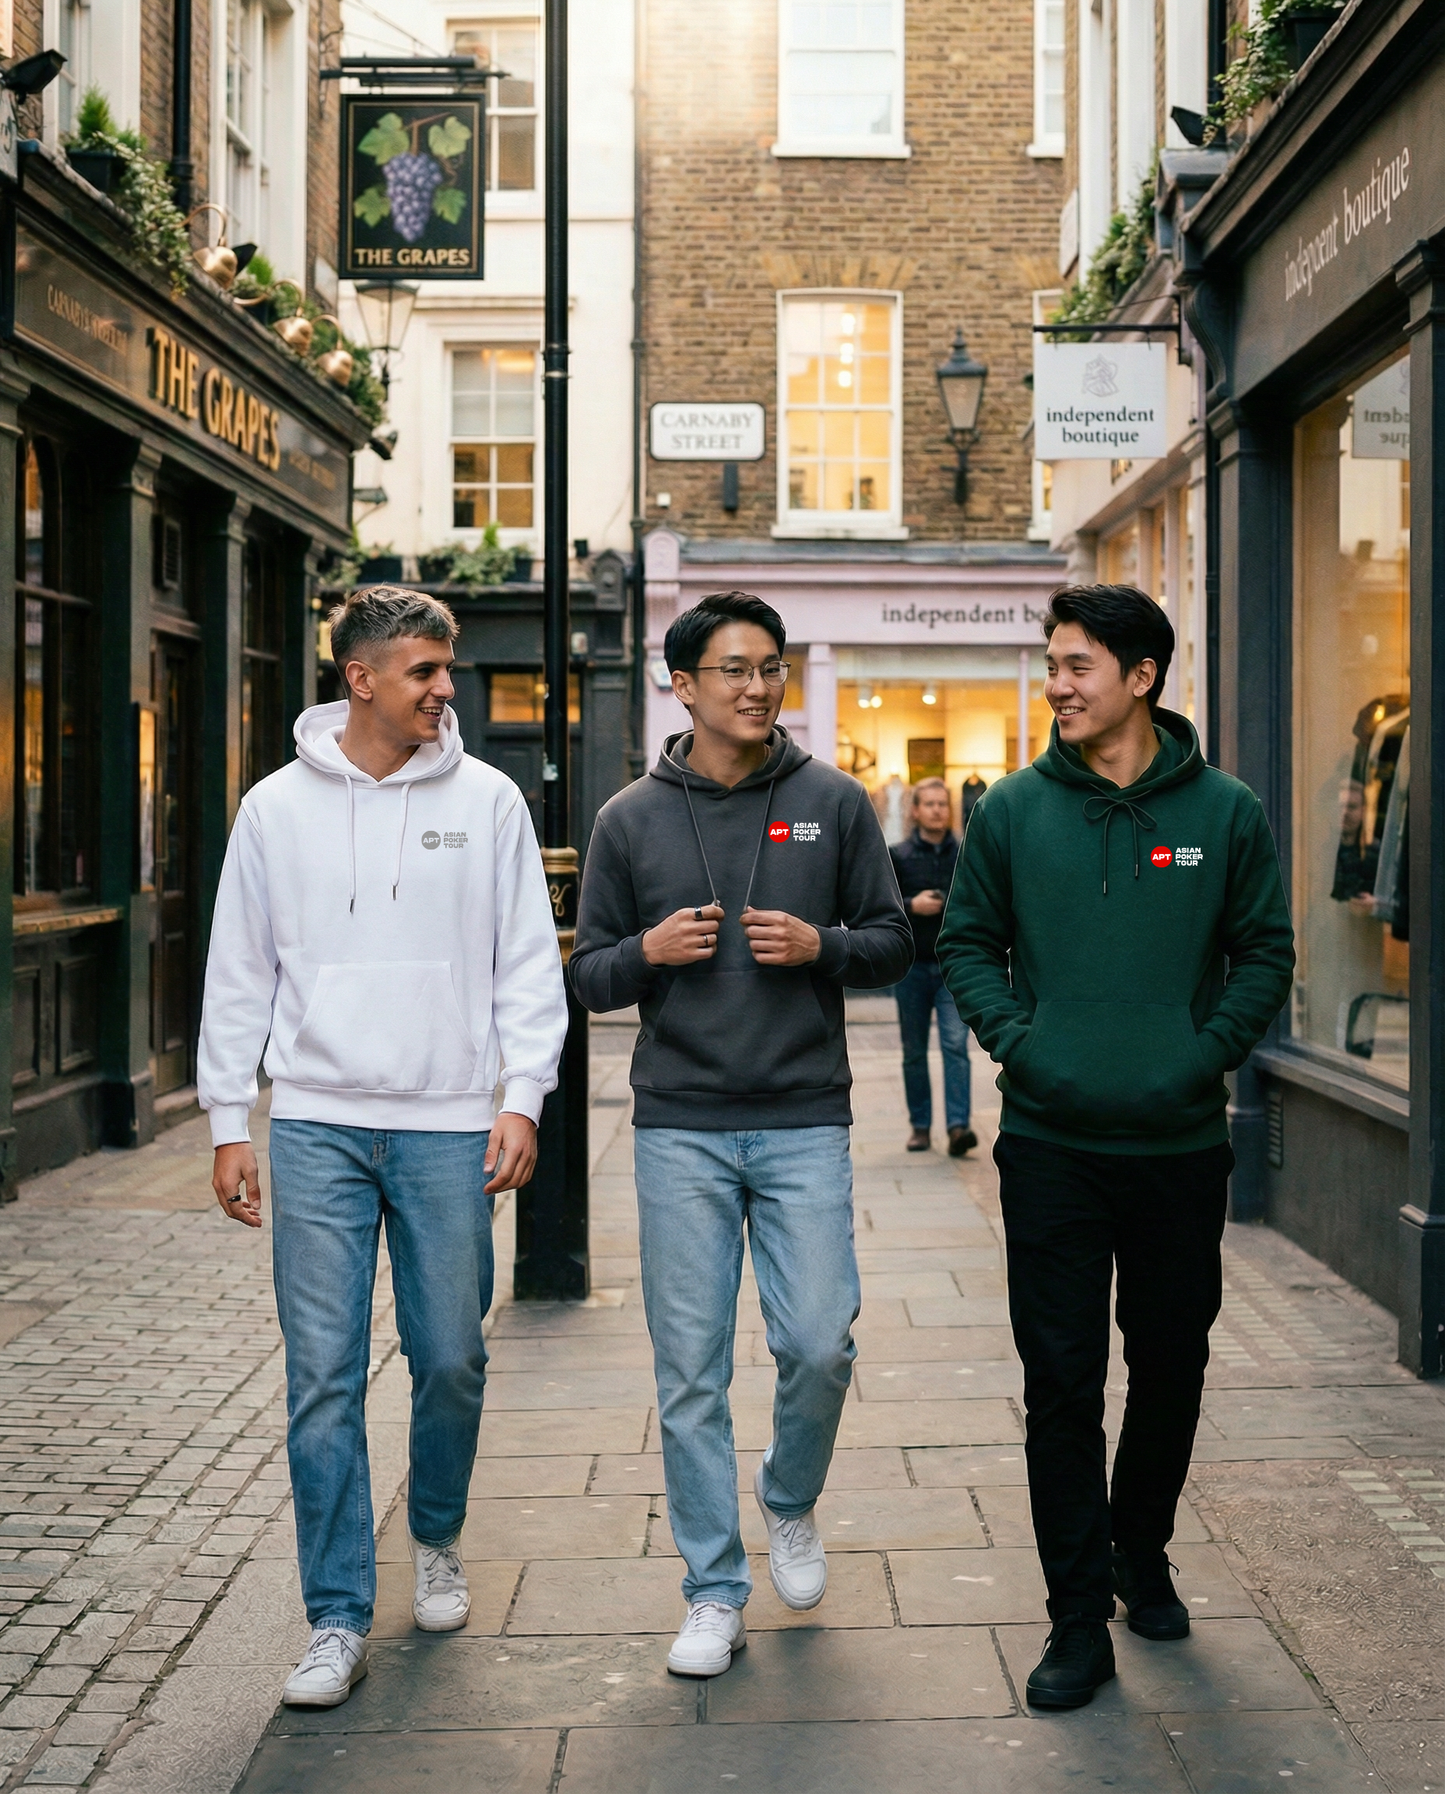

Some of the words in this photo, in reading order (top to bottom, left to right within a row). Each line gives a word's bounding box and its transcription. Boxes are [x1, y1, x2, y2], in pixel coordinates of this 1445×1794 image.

[1343, 147, 1410, 245] boutique
[354, 248, 393, 265] THE
[397, 248, 470, 265] GRAPES
[153, 326, 199, 420] THE
[203, 366, 281, 472] GRAPES
[660, 411, 757, 429] CARNABY
[1046, 405, 1155, 427] independent
[671, 433, 744, 450] STREET
[1061, 426, 1140, 448] boutique
[882, 603, 1015, 629] independent
[1023, 603, 1049, 623] bo
[769, 828, 790, 836] APT
[792, 828, 822, 836] POKER
[1152, 853, 1172, 861] APT
